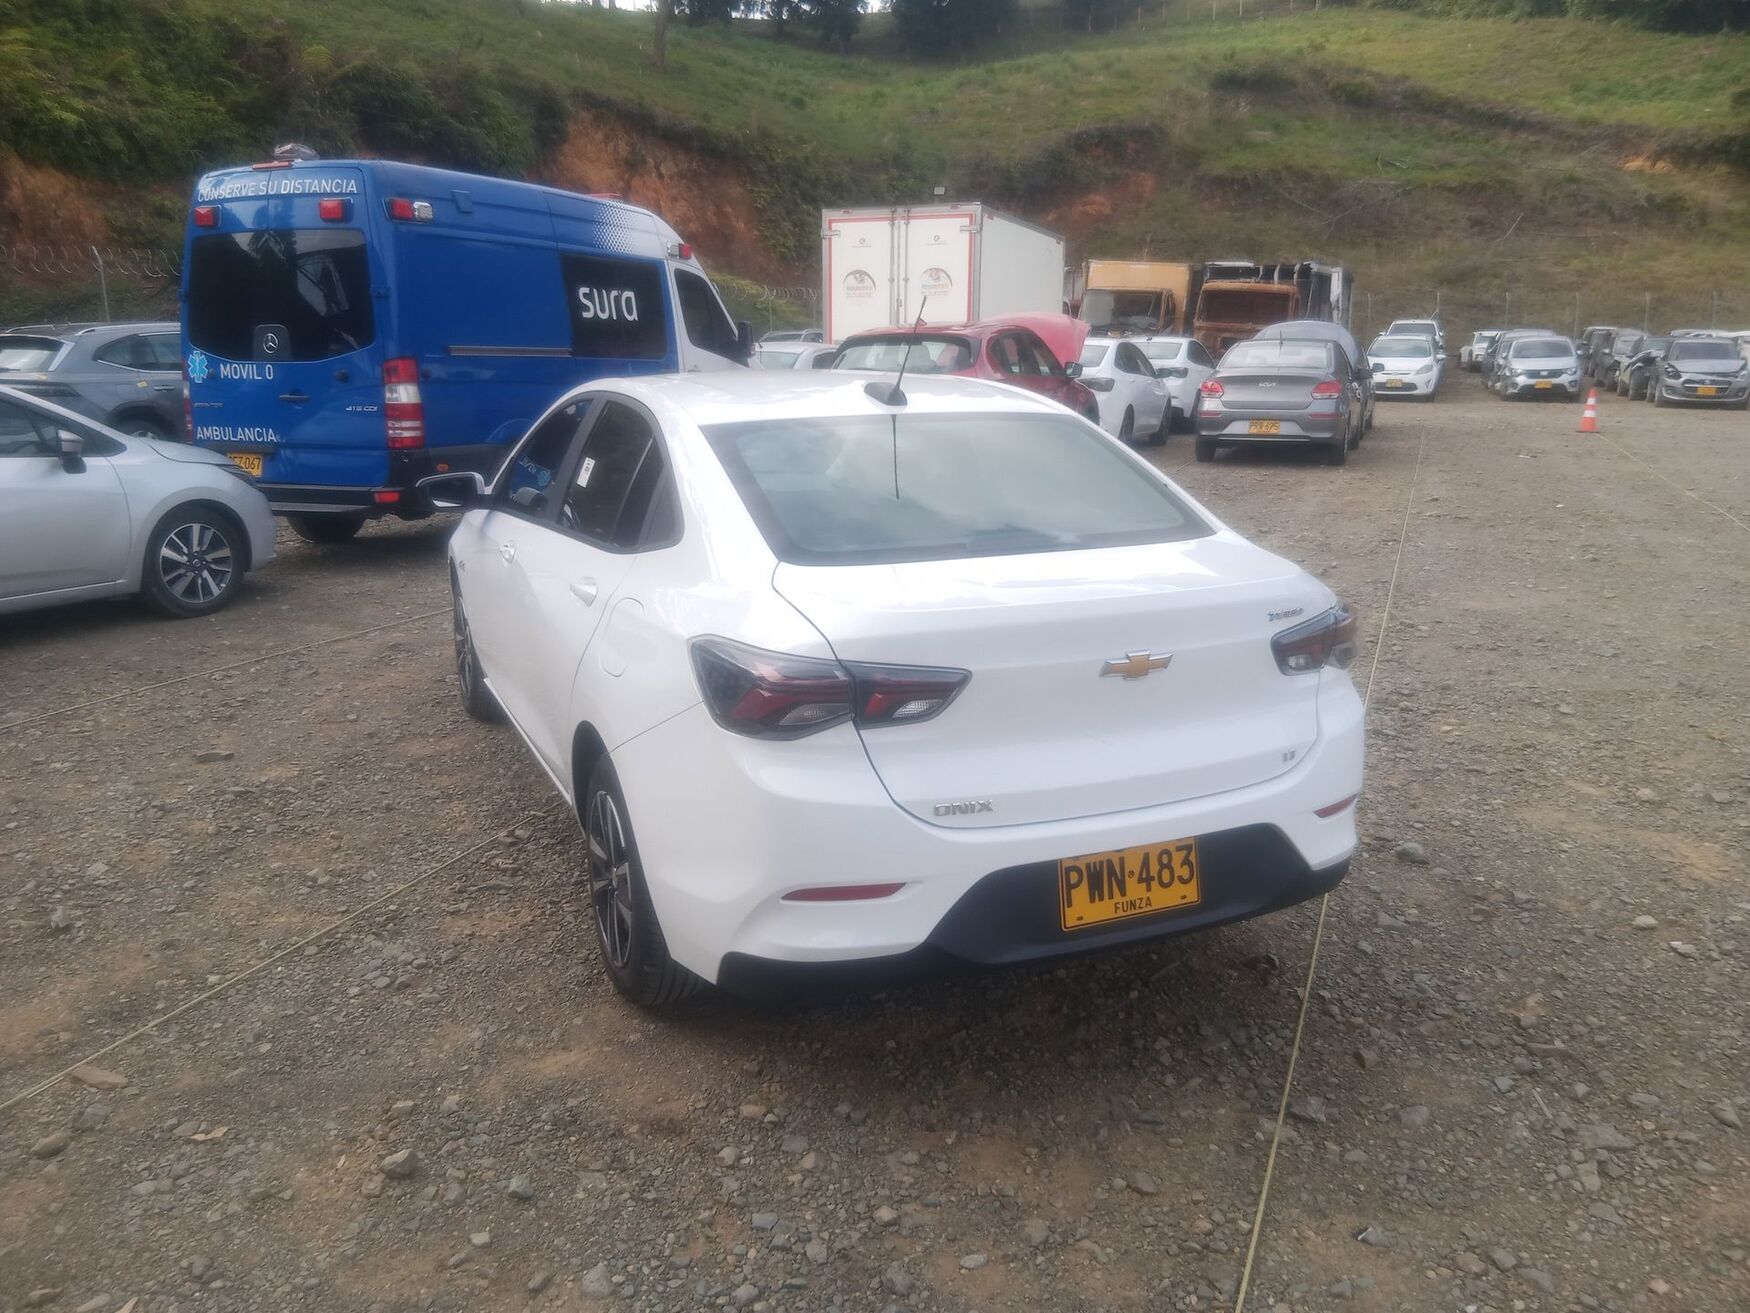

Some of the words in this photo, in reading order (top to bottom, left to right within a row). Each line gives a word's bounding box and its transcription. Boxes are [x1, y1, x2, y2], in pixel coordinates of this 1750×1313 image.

[198, 182, 256, 202] CONSERVE
[259, 180, 278, 195] SU
[281, 179, 358, 194] DISTANCIA
[578, 286, 639, 322] sura
[219, 363, 262, 380] MOVIL
[196, 427, 277, 443] AMBULANCIA
[934, 799, 994, 817] ONIX
[1113, 896, 1153, 914] FUNZA
